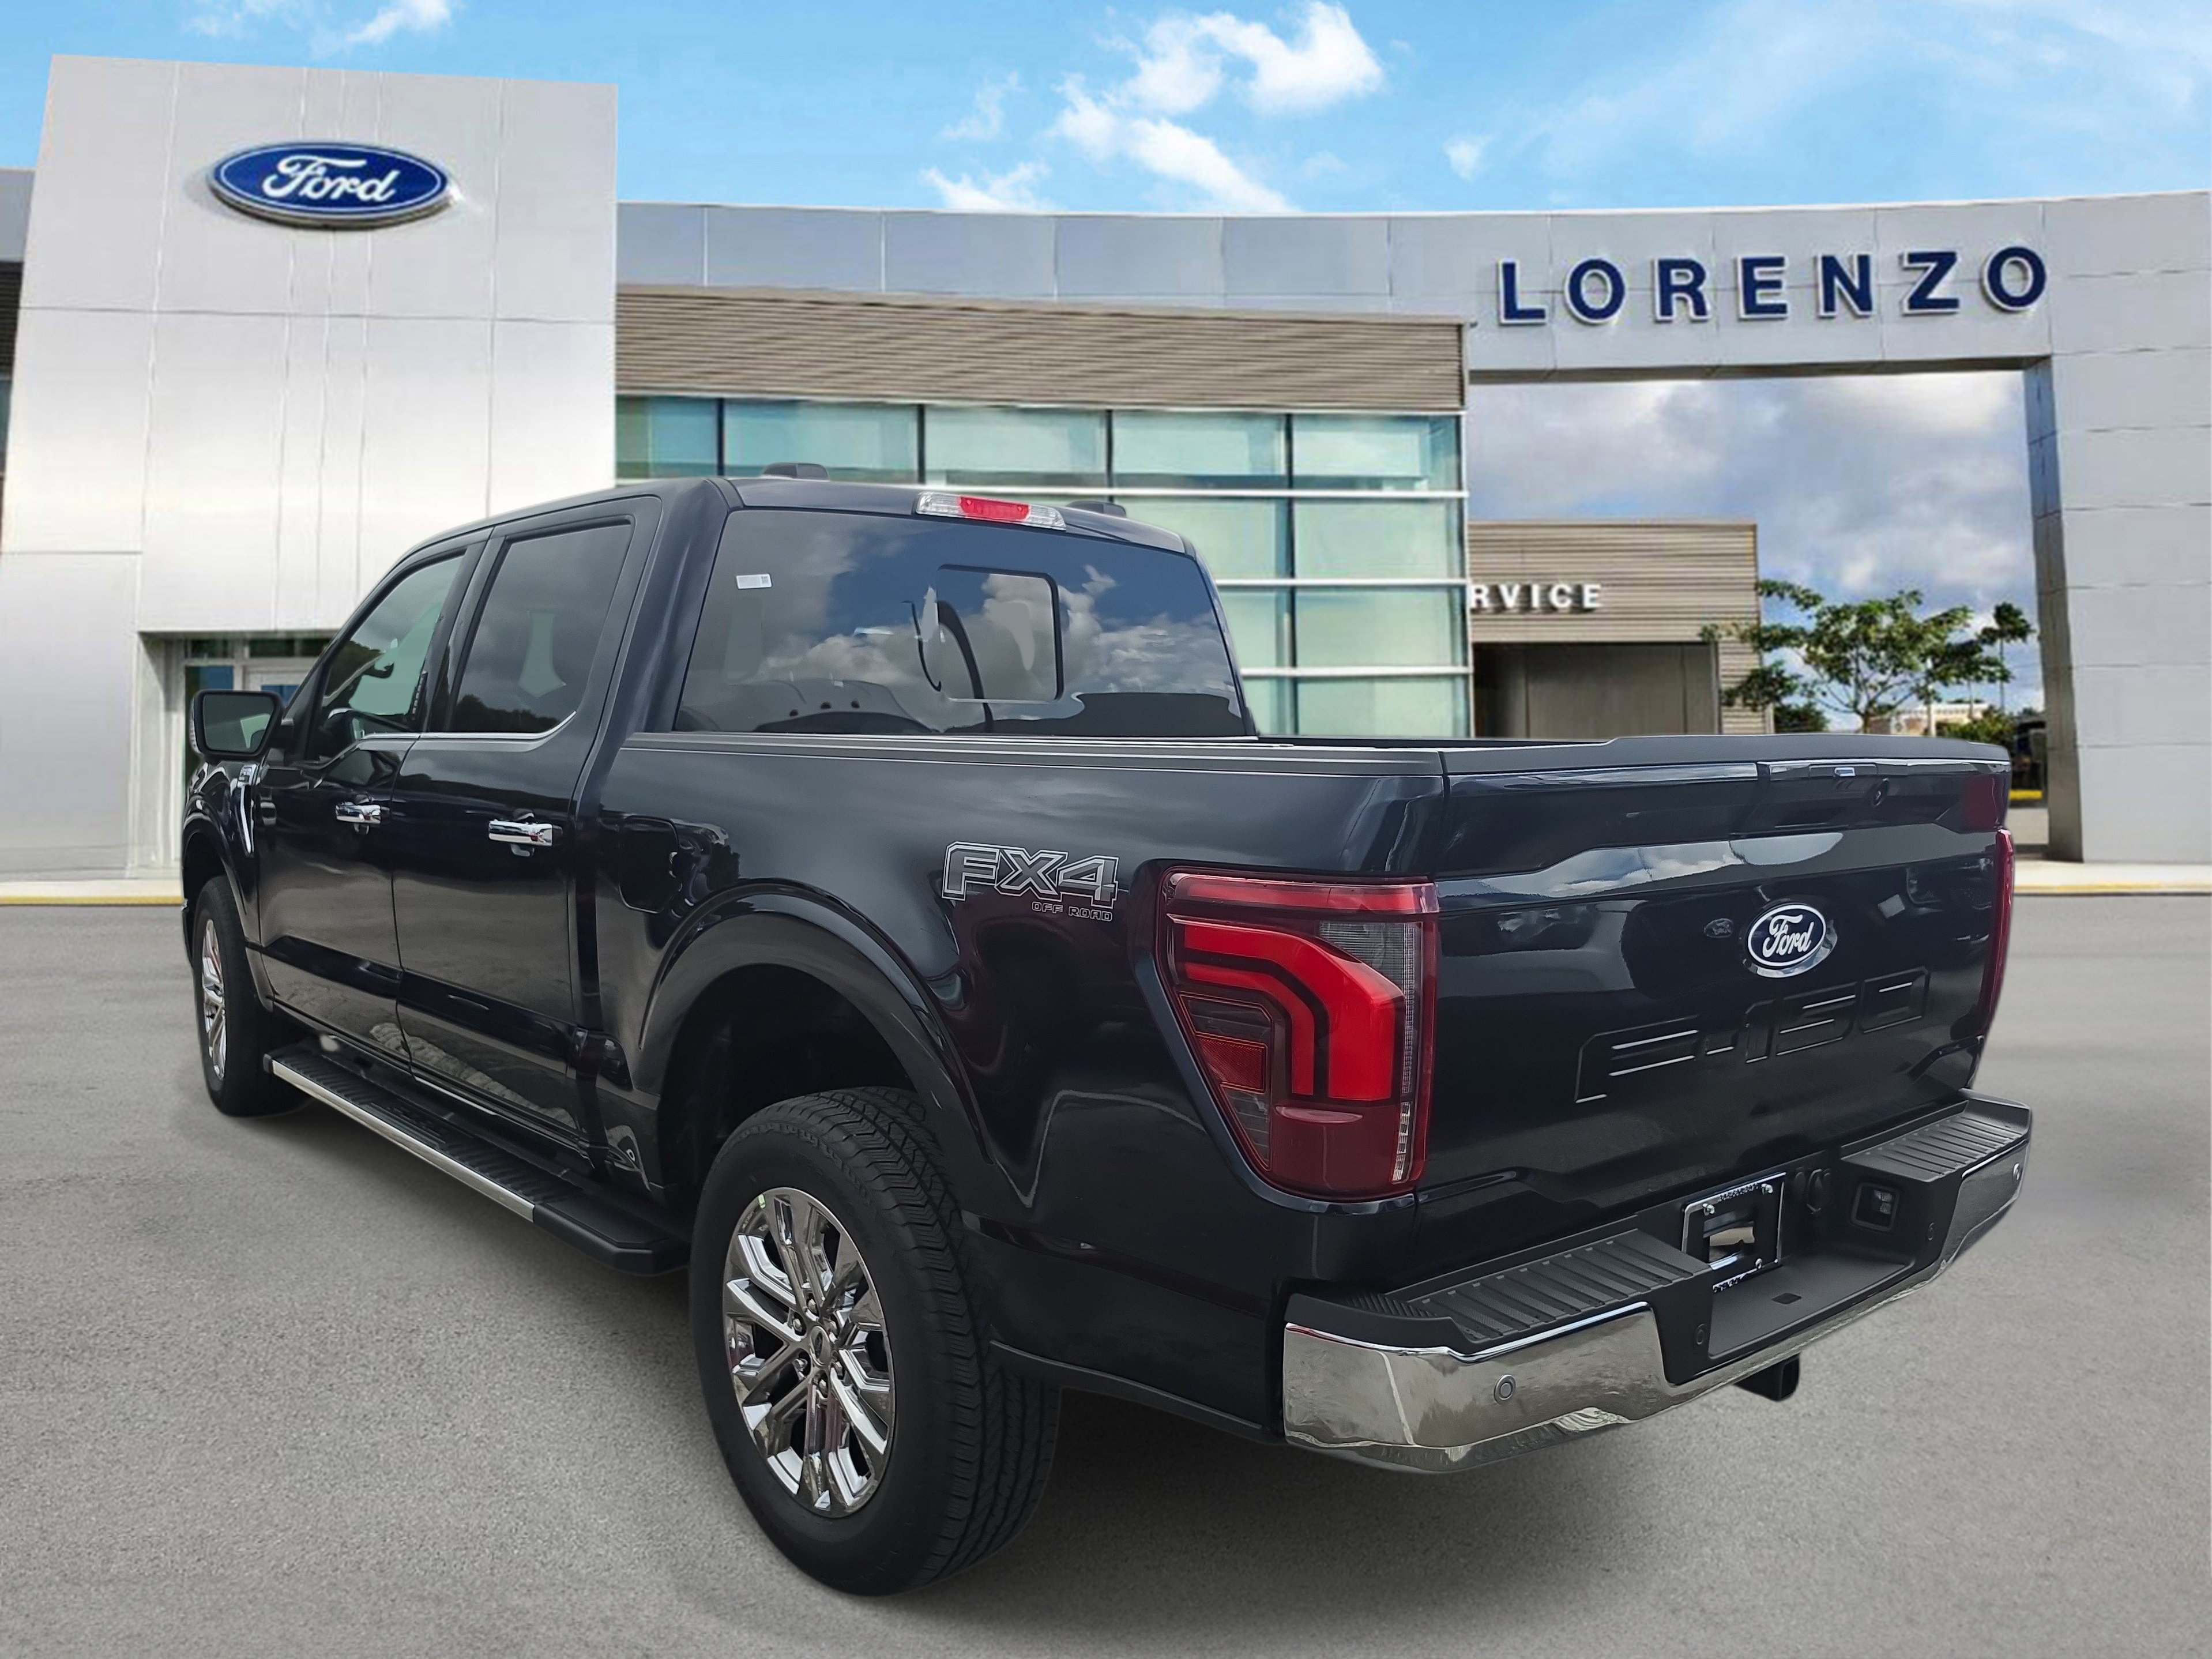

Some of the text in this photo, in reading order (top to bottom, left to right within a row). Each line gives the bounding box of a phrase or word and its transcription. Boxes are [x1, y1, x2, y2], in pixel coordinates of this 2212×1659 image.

[262, 155, 401, 202] Ford
[1499, 246, 2047, 324] LORENZO
[942, 841, 1119, 909] FX4
[1032, 901, 1113, 922] OFF ROAD
[1762, 914, 1815, 958] Ford
[1575, 966, 1931, 1104] F-150
